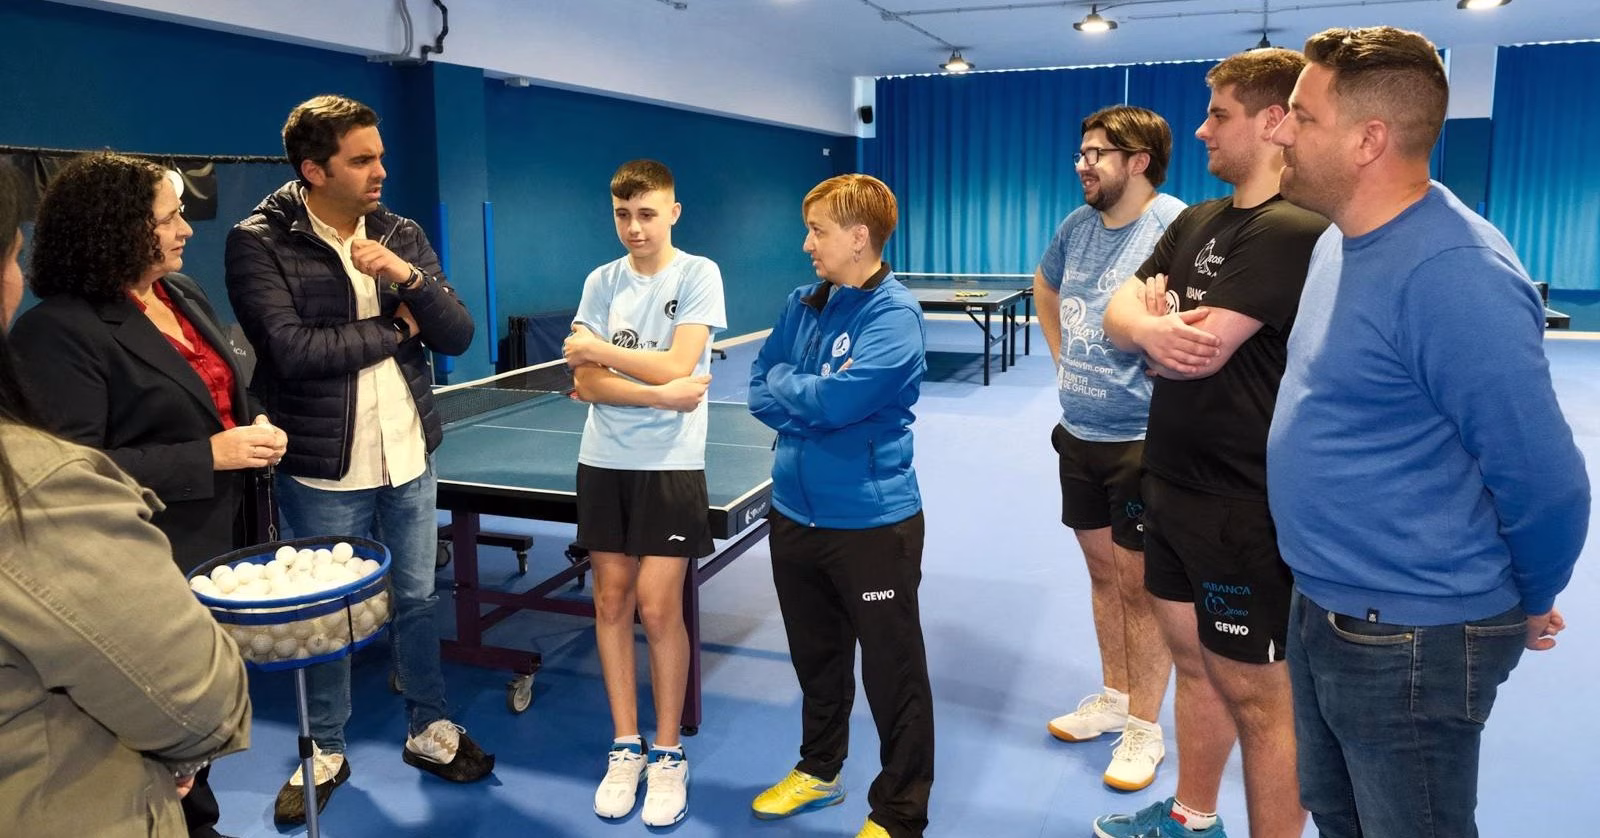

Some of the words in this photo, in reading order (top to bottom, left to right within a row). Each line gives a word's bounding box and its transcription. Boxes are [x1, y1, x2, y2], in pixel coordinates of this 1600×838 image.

[1072, 383, 1107, 398] GALICIA
[862, 589, 895, 601] GEWO
[1215, 621, 1249, 636] GEWO
